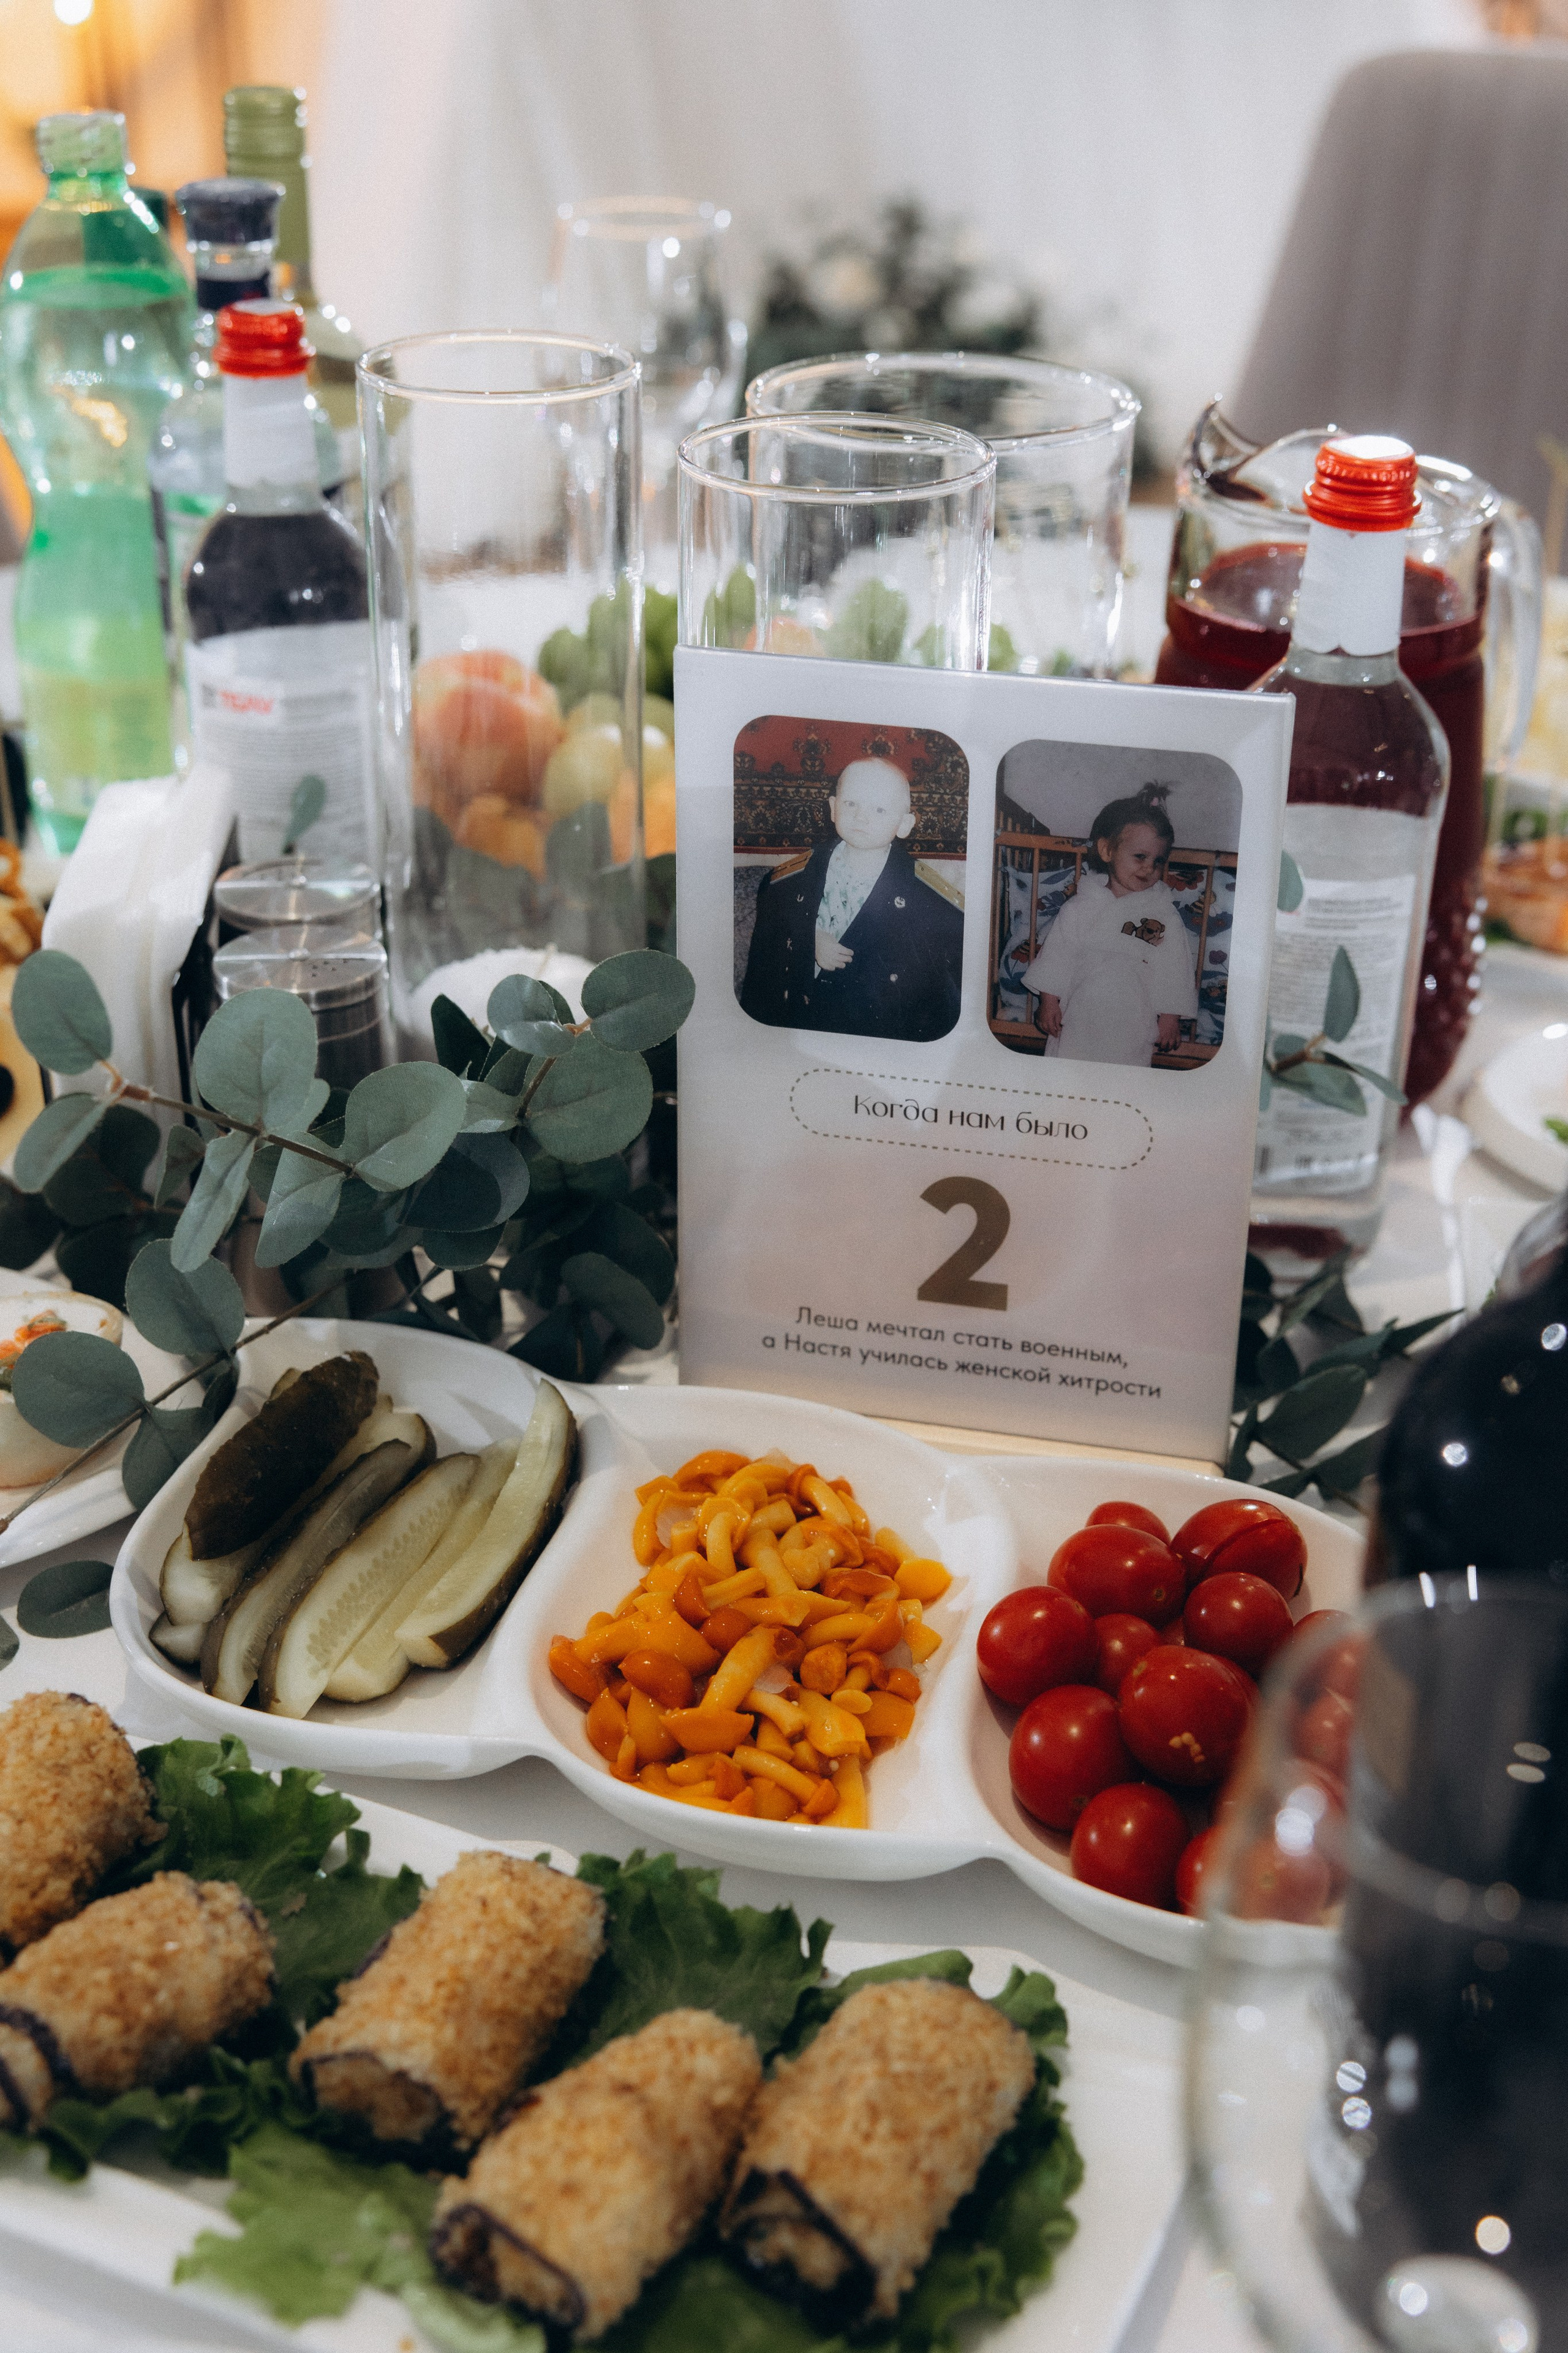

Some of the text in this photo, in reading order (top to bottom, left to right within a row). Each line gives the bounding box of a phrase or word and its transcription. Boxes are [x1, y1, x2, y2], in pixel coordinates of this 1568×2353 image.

[854, 1094, 1089, 1140] Когда нам было
[916, 1175, 1011, 1312] 2
[761, 1332, 1162, 1399] а Настя училась женской хитрости
[796, 1305, 1128, 1369] Леша мечтал стать военным,
